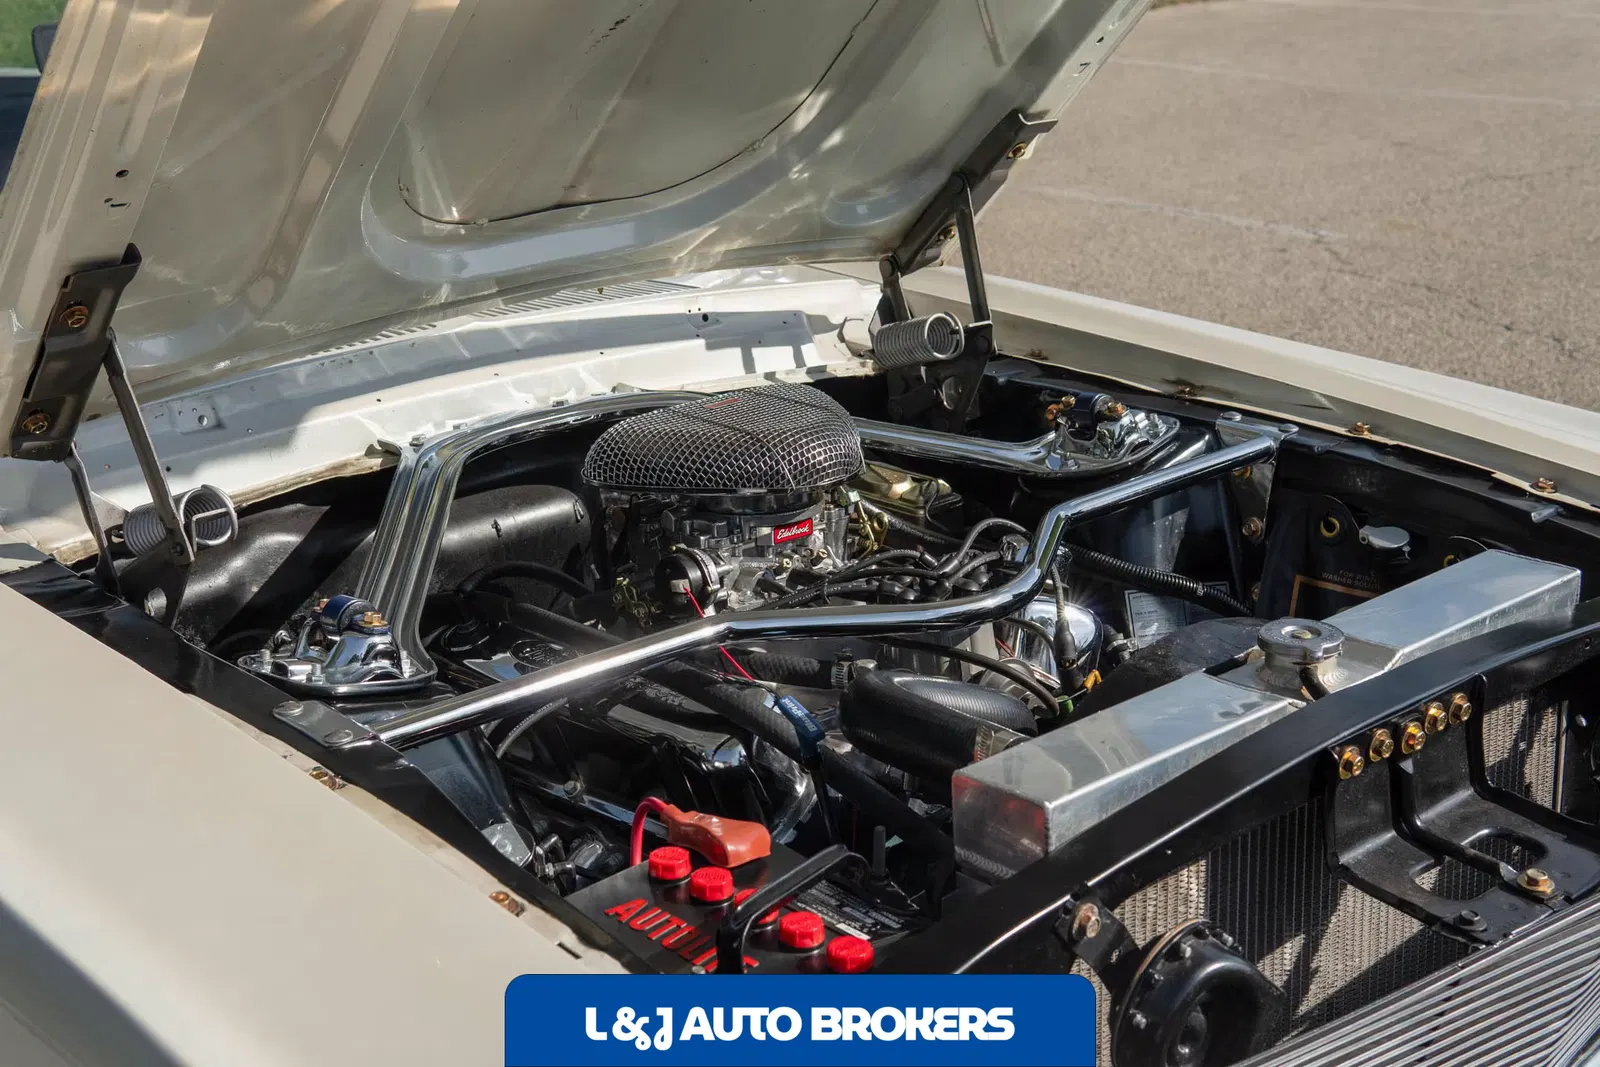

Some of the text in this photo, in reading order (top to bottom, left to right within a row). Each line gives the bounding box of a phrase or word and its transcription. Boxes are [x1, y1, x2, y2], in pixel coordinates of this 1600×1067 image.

[777, 524, 809, 539] Edelbrock
[781, 698, 818, 731] BluePrint
[604, 898, 760, 974] AUTOLI
